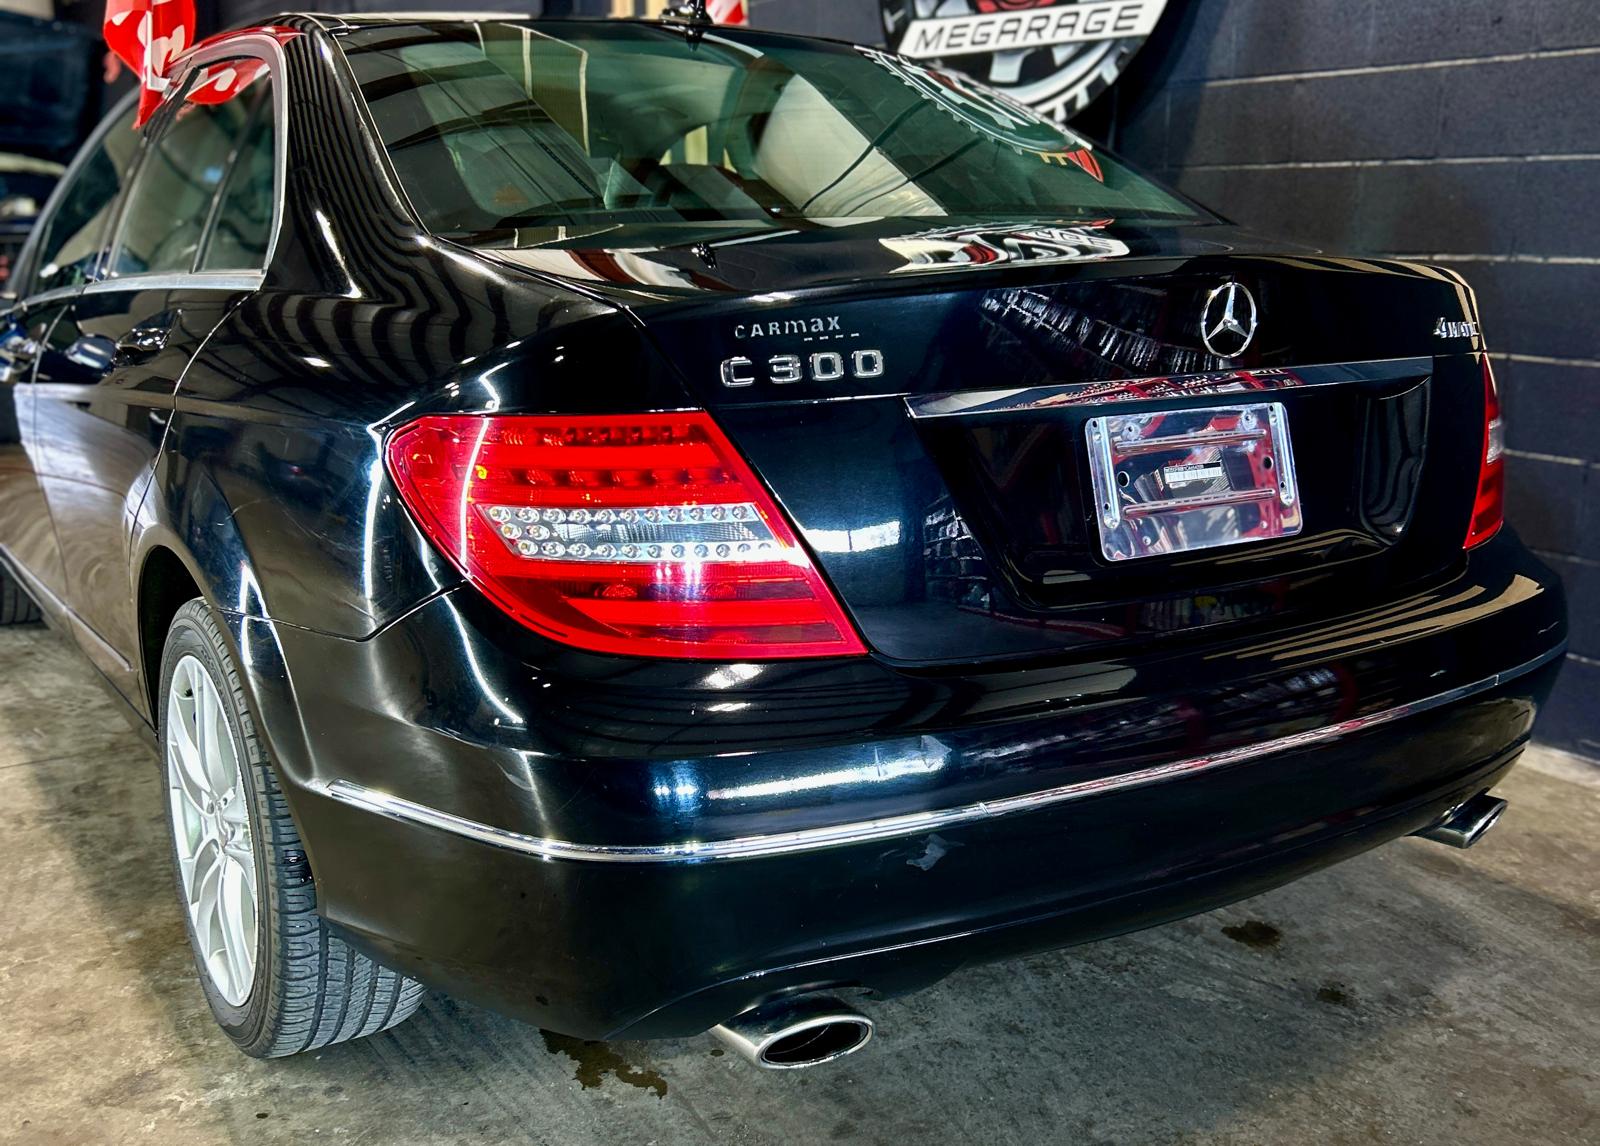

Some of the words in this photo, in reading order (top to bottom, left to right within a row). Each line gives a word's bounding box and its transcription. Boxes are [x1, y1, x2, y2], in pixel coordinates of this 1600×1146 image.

[914, 4, 1142, 51] MEGARAGE
[720, 356, 755, 387] C
[768, 349, 884, 384] 300
